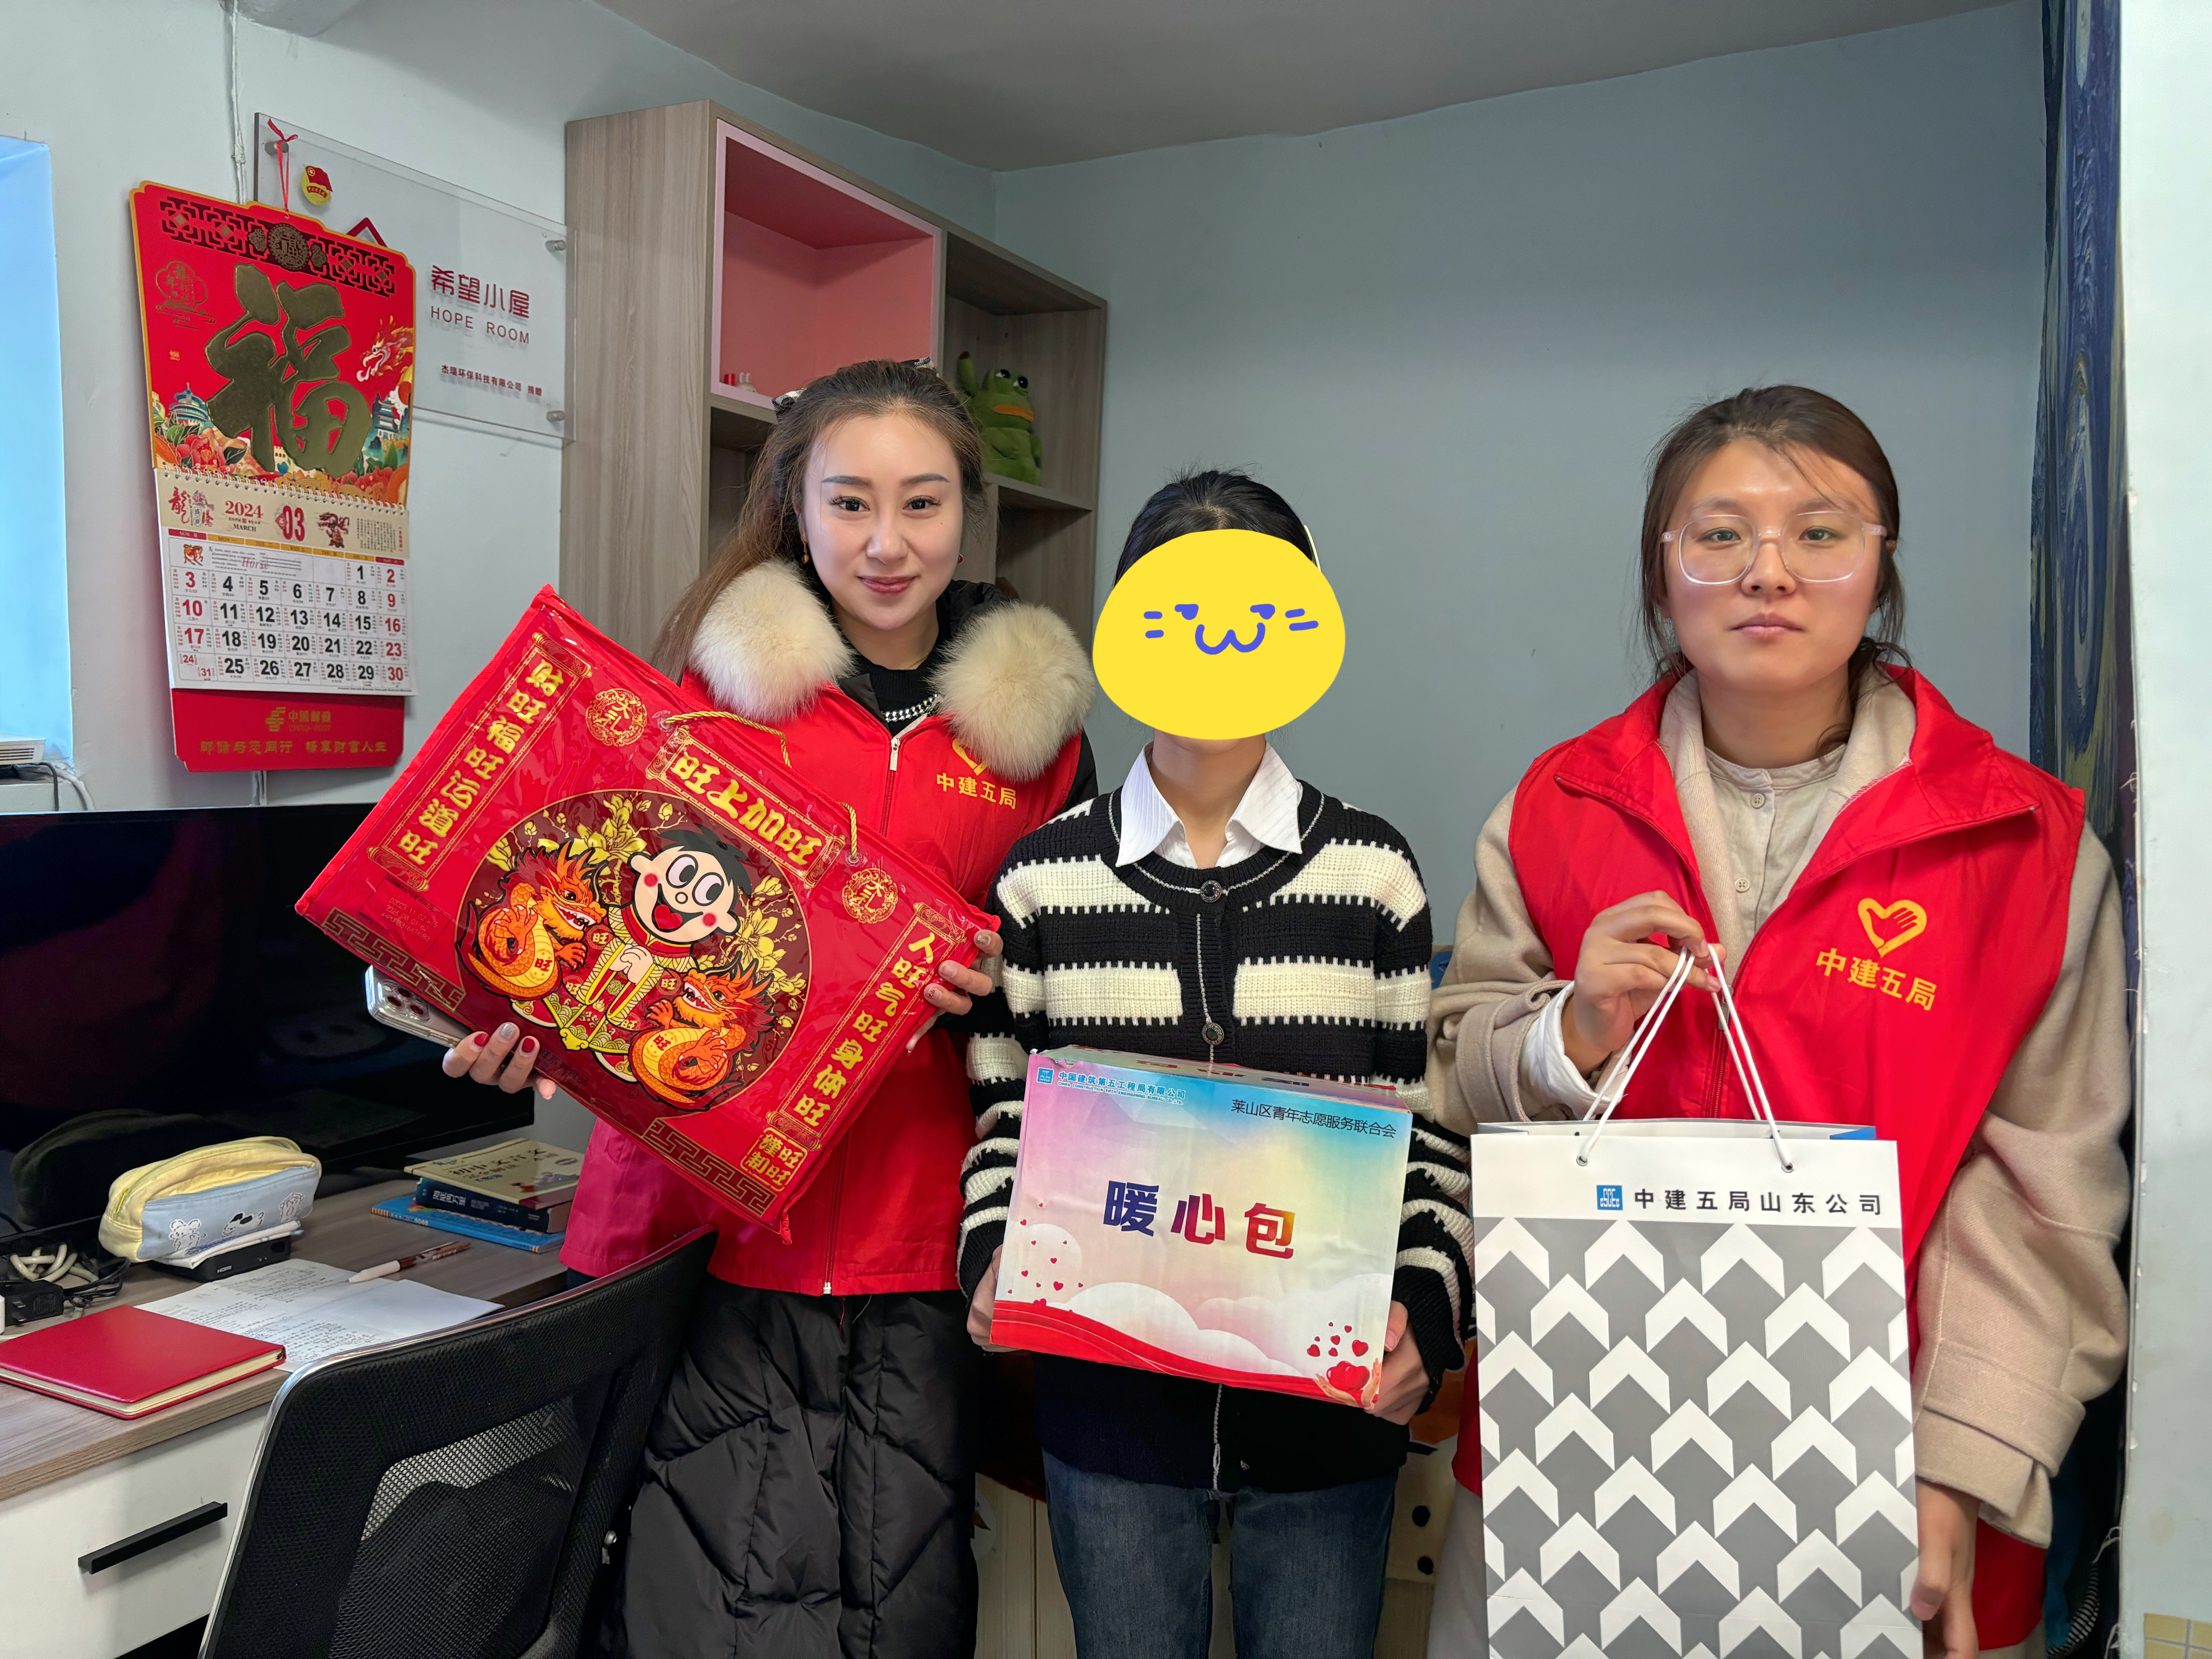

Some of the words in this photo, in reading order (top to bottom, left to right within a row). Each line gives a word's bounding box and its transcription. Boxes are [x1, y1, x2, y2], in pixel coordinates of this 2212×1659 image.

[430, 265, 530, 319] 希望小屋
[430, 306, 474, 329] HOPE
[486, 321, 530, 345] ROOM
[205, 262, 373, 479] 福
[441, 365, 521, 392] 杰瑞环保科技有限公司
[225, 500, 264, 519] 2024
[282, 505, 305, 542] 03
[233, 523, 257, 532] MARCH
[358, 566, 363, 579] 1
[387, 569, 395, 583] 2
[186, 571, 195, 588] 3
[223, 576, 233, 591] 4
[260, 580, 268, 595] 5
[293, 584, 302, 598] 6
[326, 588, 334, 602] 7
[358, 591, 366, 605] 8
[387, 594, 396, 608] 9
[183, 599, 203, 616] 10
[220, 603, 238, 619] 11
[256, 606, 275, 623] 12
[291, 609, 308, 625] 13
[323, 612, 341, 628] 14
[355, 615, 371, 630] 15
[385, 617, 401, 632] 16
[184, 628, 204, 644] 17
[222, 631, 241, 647] 18
[258, 633, 276, 649] 19
[292, 636, 310, 651] 20
[325, 638, 340, 653] 21
[356, 640, 373, 655] 22
[386, 642, 402, 657] 23
[183, 655, 194, 664] 24
[224, 658, 244, 674] 25
[260, 660, 279, 676] 26
[294, 662, 312, 677] 27
[326, 664, 344, 679] 28
[358, 665, 374, 680] 29
[387, 666, 403, 681] 30
[201, 668, 211, 677] 31
[397, 660, 564, 865] 财旺福旺运道旺
[936, 772, 1017, 810] 中建五局
[671, 751, 824, 866] 旺上加旺
[592, 932, 609, 946] 旺
[534, 957, 553, 972] 旺
[660, 978, 676, 990] 旺
[1816, 948, 1937, 1011] 中建五局
[653, 1035, 671, 1051] 旺
[793, 932, 937, 1128] 人旺气旺身体旺
[1058, 1071, 1186, 1099] 中国建筑第五工程局有限公司
[1072, 1083, 1104, 1093] CONSTRUCTION
[1118, 1090, 1145, 1099] ENGINEERING
[1231, 1098, 1397, 1139] 莱山区青年志愿服务联合会
[433, 1190, 467, 1207] 海底两万里
[1634, 1188, 1883, 1216] 中建五局山东公司
[1102, 1179, 1296, 1260] 暖心包
